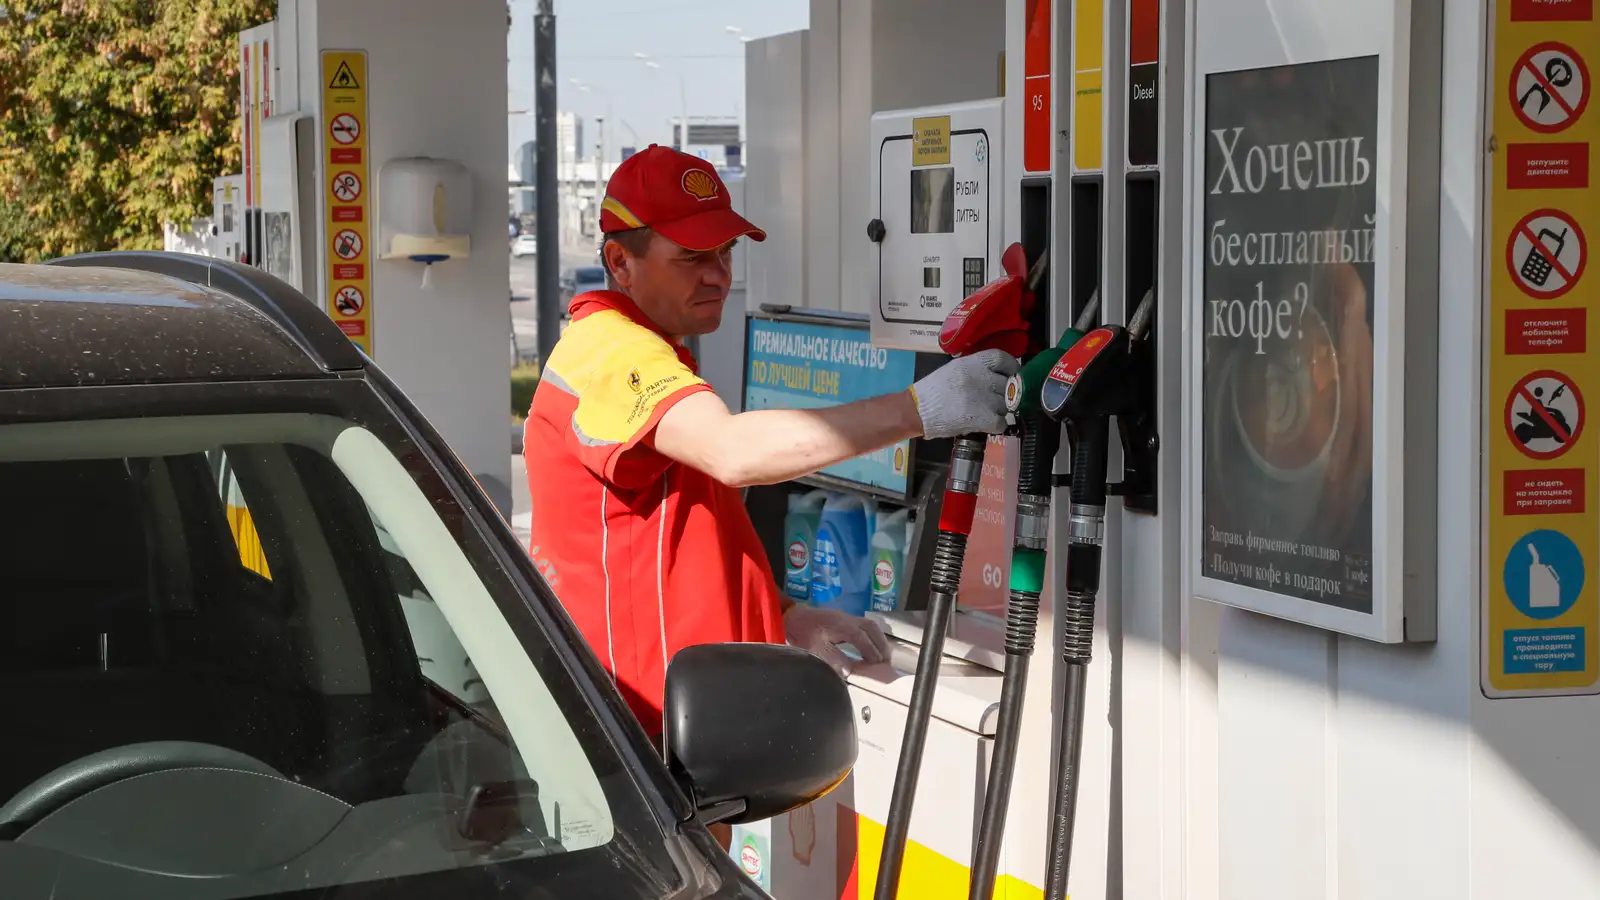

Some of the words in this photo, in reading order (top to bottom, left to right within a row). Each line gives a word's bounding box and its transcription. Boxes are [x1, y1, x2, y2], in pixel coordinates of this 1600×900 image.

[1133, 80, 1155, 100] Diesel
[1032, 95, 1043, 111] 95
[1210, 127, 1370, 194] Хочешь
[955, 181, 979, 196] РУБЛИ
[955, 208, 980, 223] ЛИТРЫ
[1210, 213, 1376, 267] бесплатный
[1210, 281, 1309, 355] кофе?
[1522, 328, 1569, 336] мобильный
[753, 330, 829, 361] ПРЕМИАЛЬНОЕ
[830, 339, 887, 370] КАЧЕСТВО
[1528, 338, 1563, 347] телефон
[752, 360, 767, 384] ПО
[768, 361, 811, 391] ЛУЧШЕЙ
[812, 370, 841, 396] ЦЕНЕ
[1053, 367, 1076, 381] V-Power
[645, 375, 679, 393] PARTNER
[1537, 480, 1564, 488] сидеть
[1528, 489, 1573, 497] мотоцикле
[1516, 500, 1532, 508] при
[1534, 499, 1572, 507] заправке
[1209, 525, 1244, 547] Заправь
[1246, 531, 1298, 555] фирменное
[1300, 544, 1341, 562] топливо
[875, 566, 893, 580] SINTEC
[982, 562, 1003, 589] GO
[1255, 563, 1281, 588] кофе
[1285, 574, 1290, 585] в
[1294, 573, 1341, 598] подарок
[1351, 567, 1369, 585] кофе
[1516, 644, 1572, 653] производится
[1519, 652, 1575, 660] специальную
